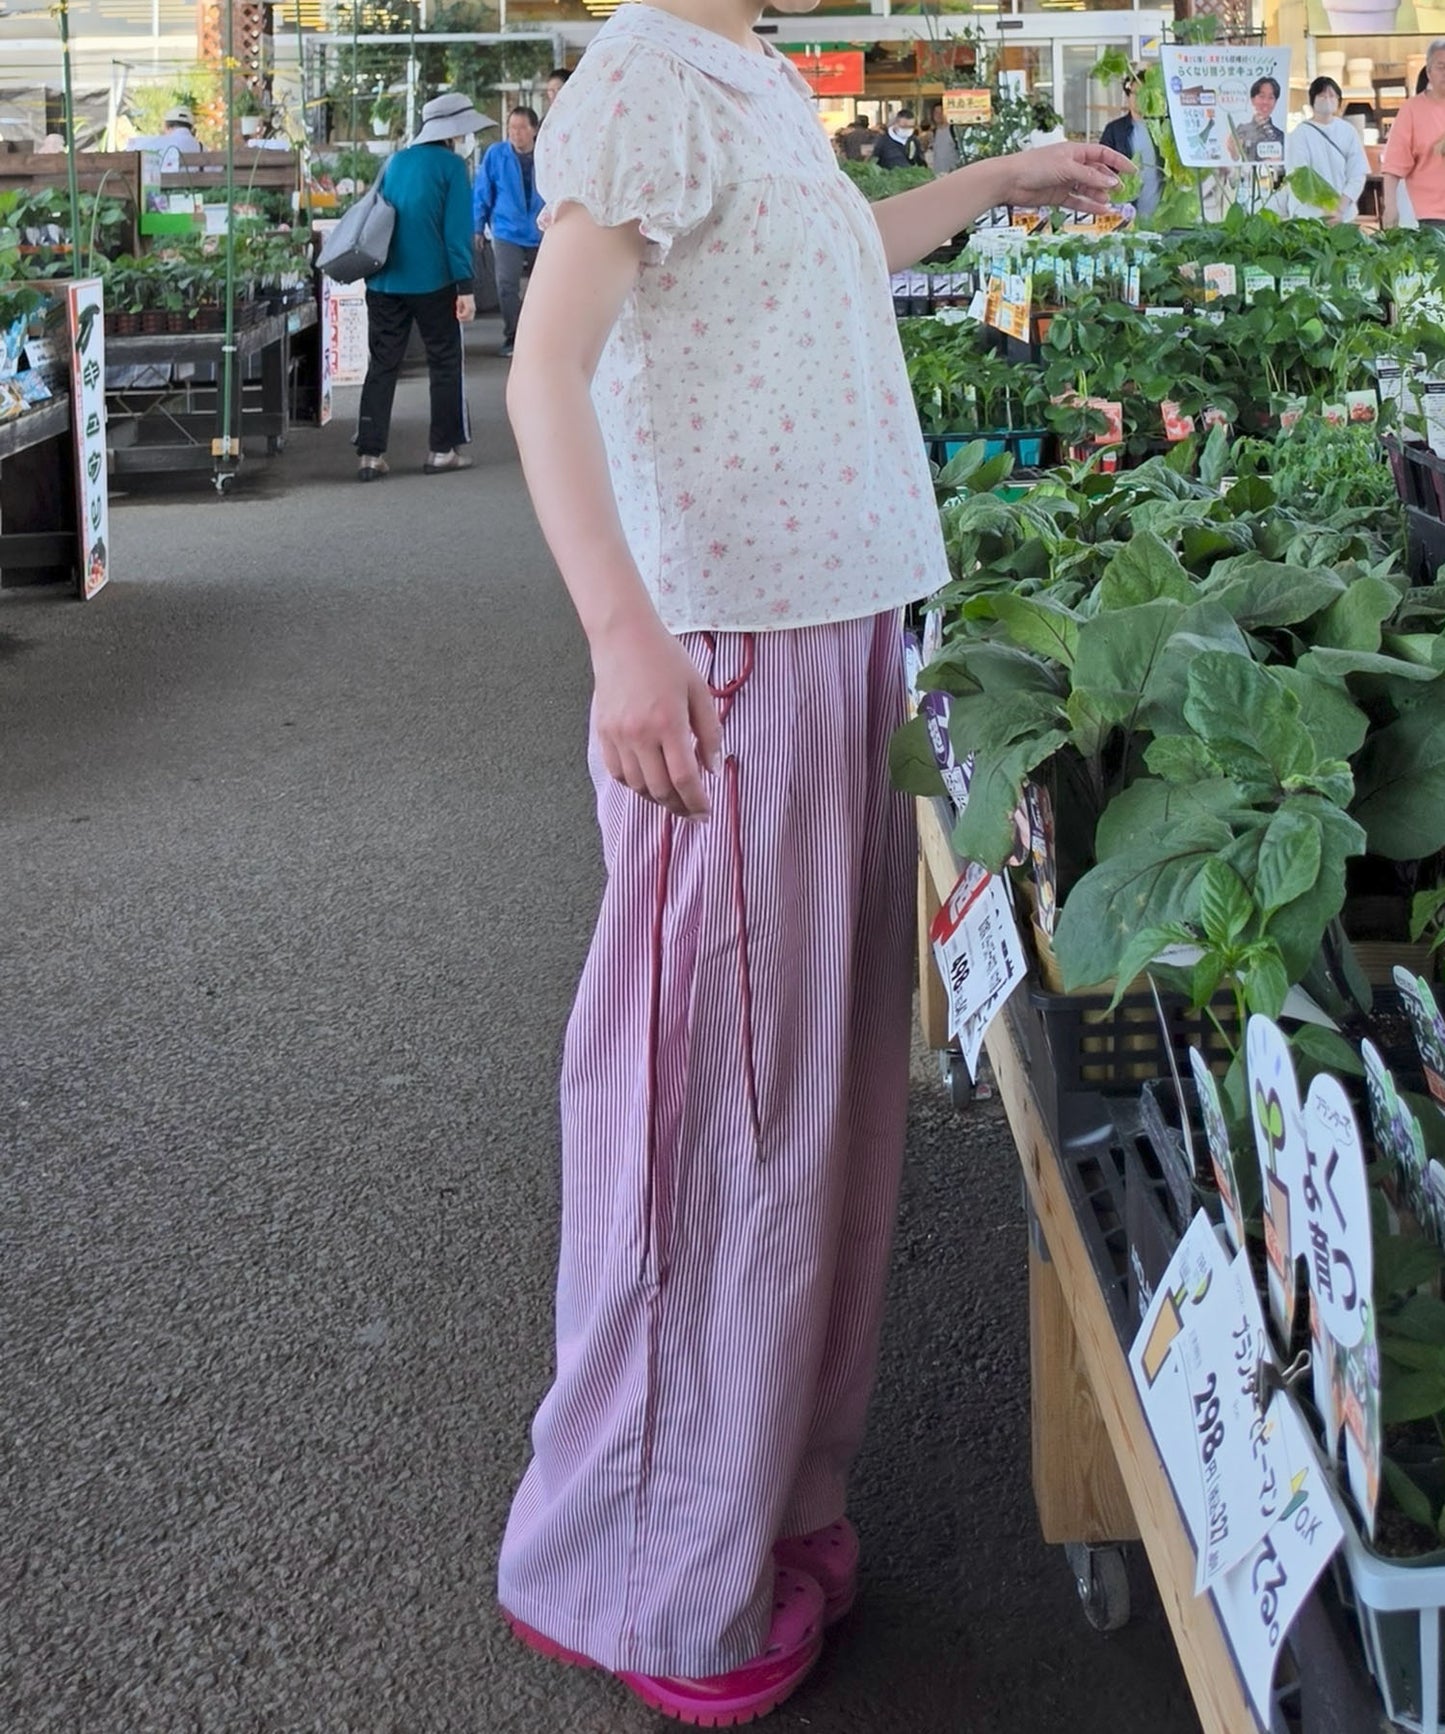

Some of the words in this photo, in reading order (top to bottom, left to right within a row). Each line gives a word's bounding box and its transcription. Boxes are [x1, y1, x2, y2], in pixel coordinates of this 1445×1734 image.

[84, 359, 102, 531] キュウリ
[952, 952, 971, 990] 498
